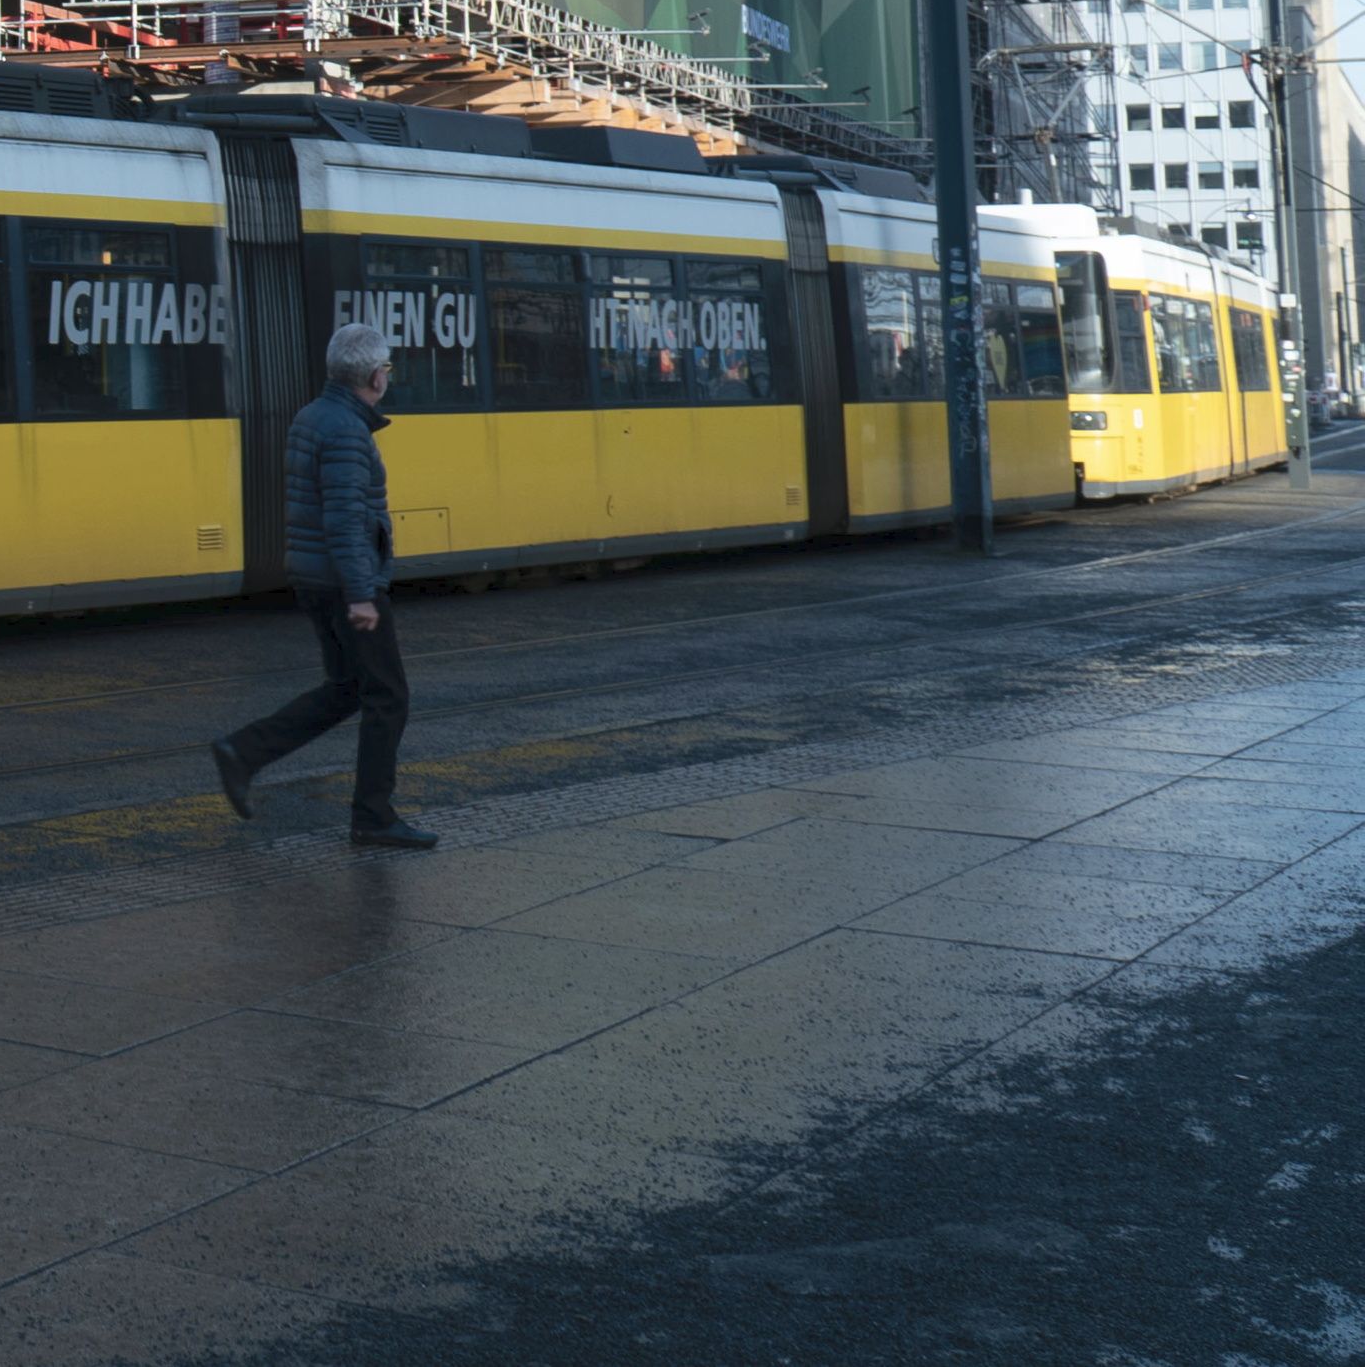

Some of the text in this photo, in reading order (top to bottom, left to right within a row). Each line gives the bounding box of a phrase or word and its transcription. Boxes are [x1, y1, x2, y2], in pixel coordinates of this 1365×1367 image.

[48, 280, 120, 345] ICH
[125, 282, 231, 345] HABE
[333, 290, 426, 348] EINEN
[627, 298, 694, 349] NACH
[700, 300, 767, 351] OBEN.
